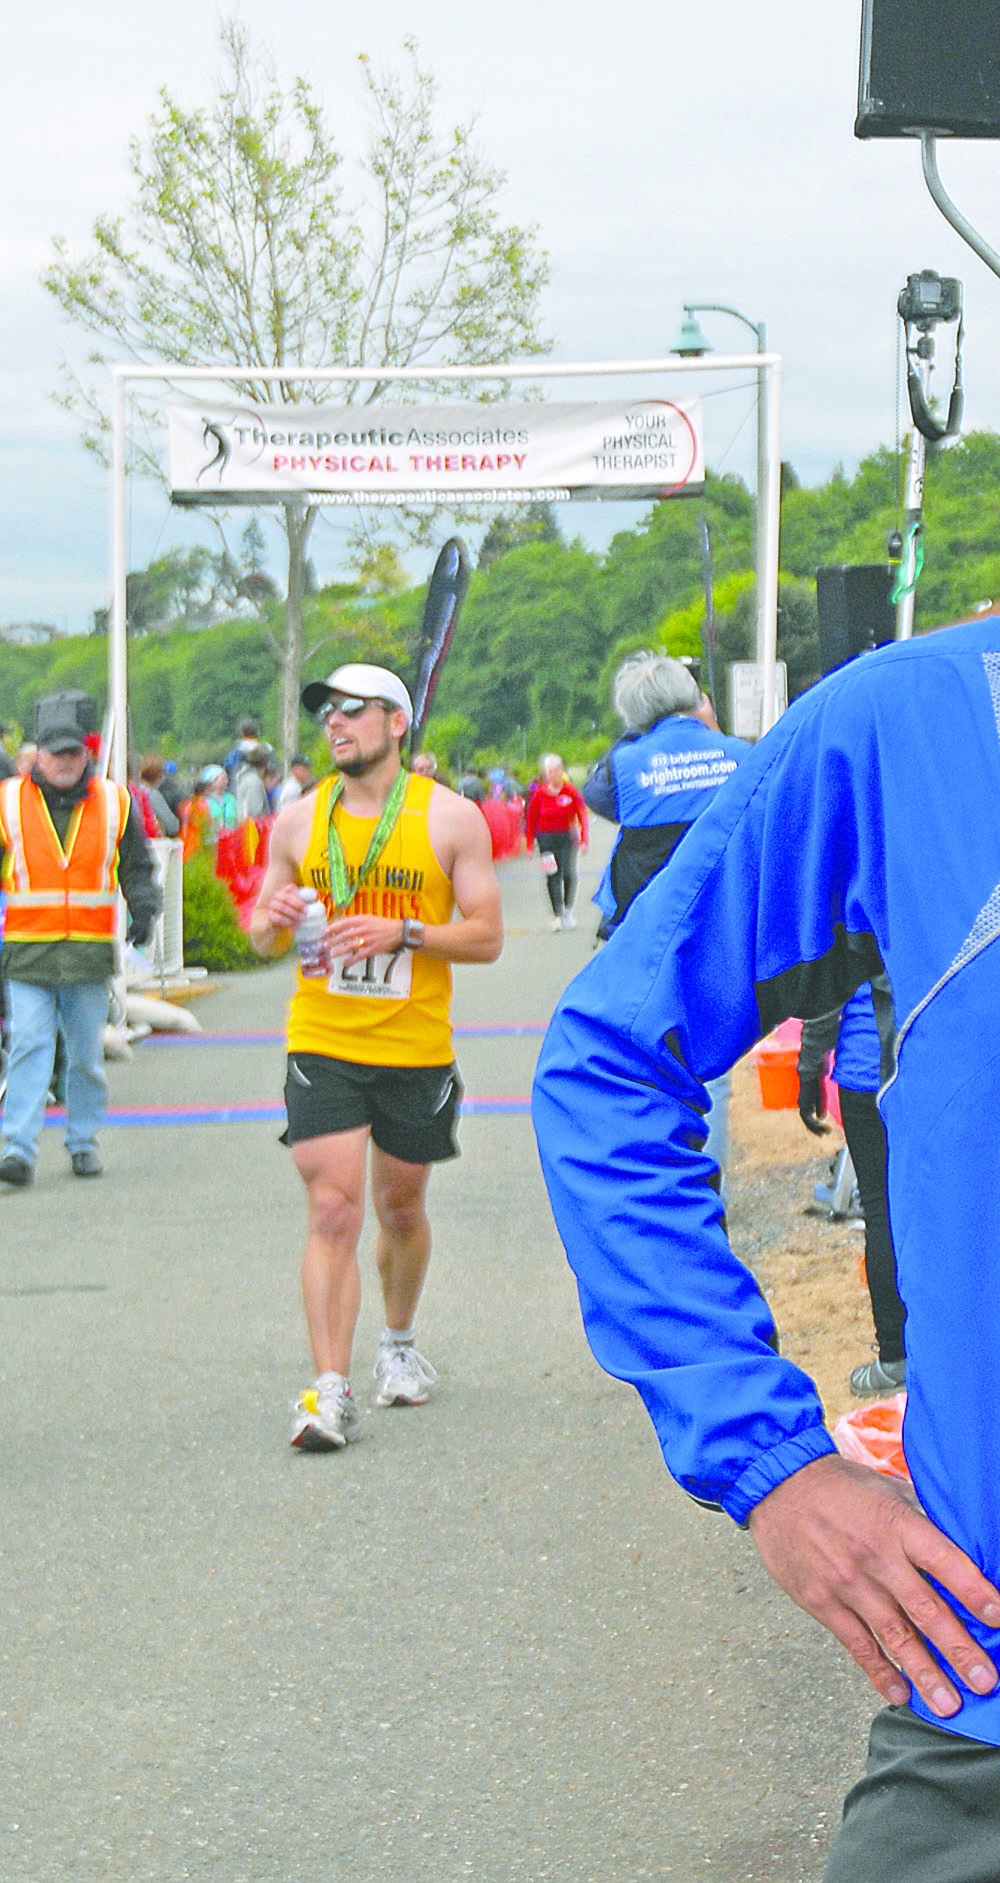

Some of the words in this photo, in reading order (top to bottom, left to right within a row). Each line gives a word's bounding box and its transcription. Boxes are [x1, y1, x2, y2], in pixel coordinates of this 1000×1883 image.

[625, 414, 667, 429] YOUR
[603, 433, 677, 450] PHYSICAL
[273, 455, 399, 472] PHYSICAL
[409, 453, 528, 471] THERAPY
[592, 453, 677, 469] THERAPIST
[307, 488, 571, 505] www.therapeuticassociates.com
[641, 760, 739, 787] brightroom.com
